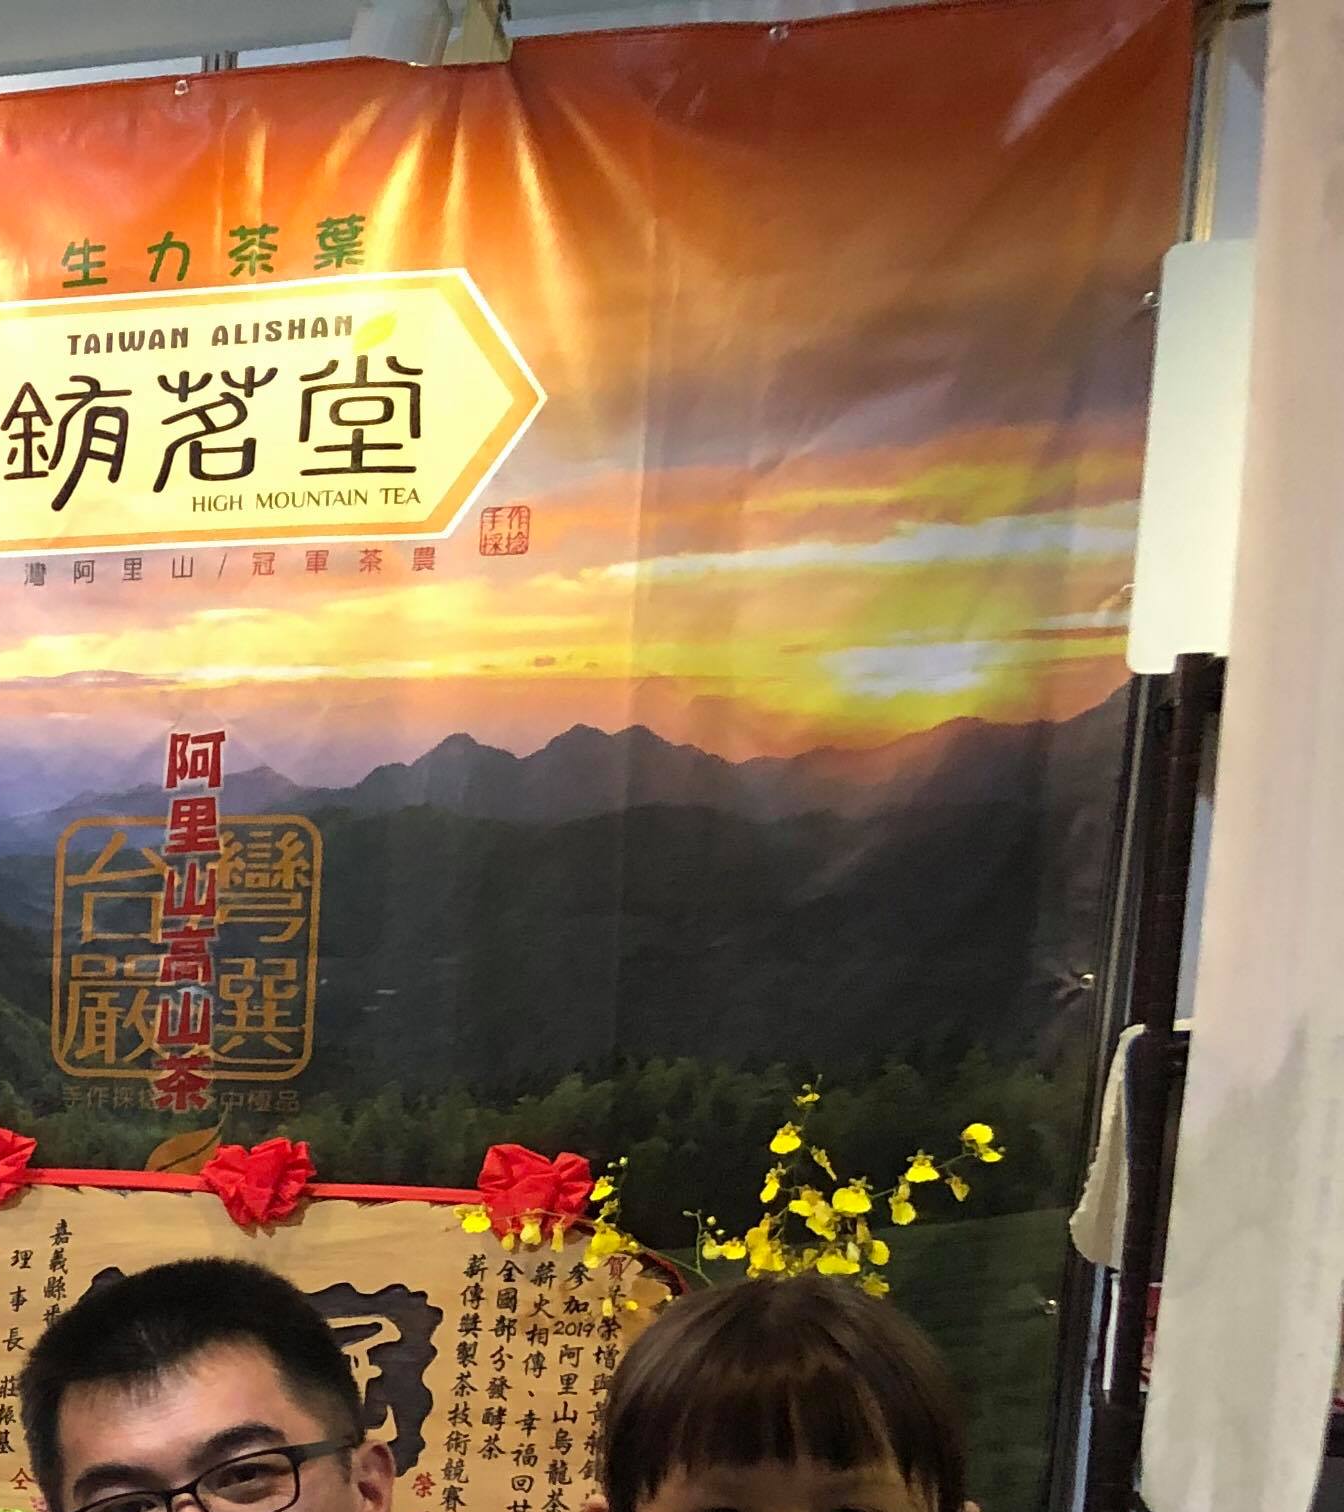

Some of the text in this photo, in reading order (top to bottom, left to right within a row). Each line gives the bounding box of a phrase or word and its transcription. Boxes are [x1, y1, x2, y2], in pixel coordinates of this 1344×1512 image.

[61, 214, 368, 290] 生力茶葉
[66, 314, 353, 356] TAIWAN ALISHAN
[191, 486, 422, 512] HIGH MOUNTAIN TEA
[152, 728, 227, 1113] 阿里山高山茶
[2, 1248, 34, 1353] 理事長
